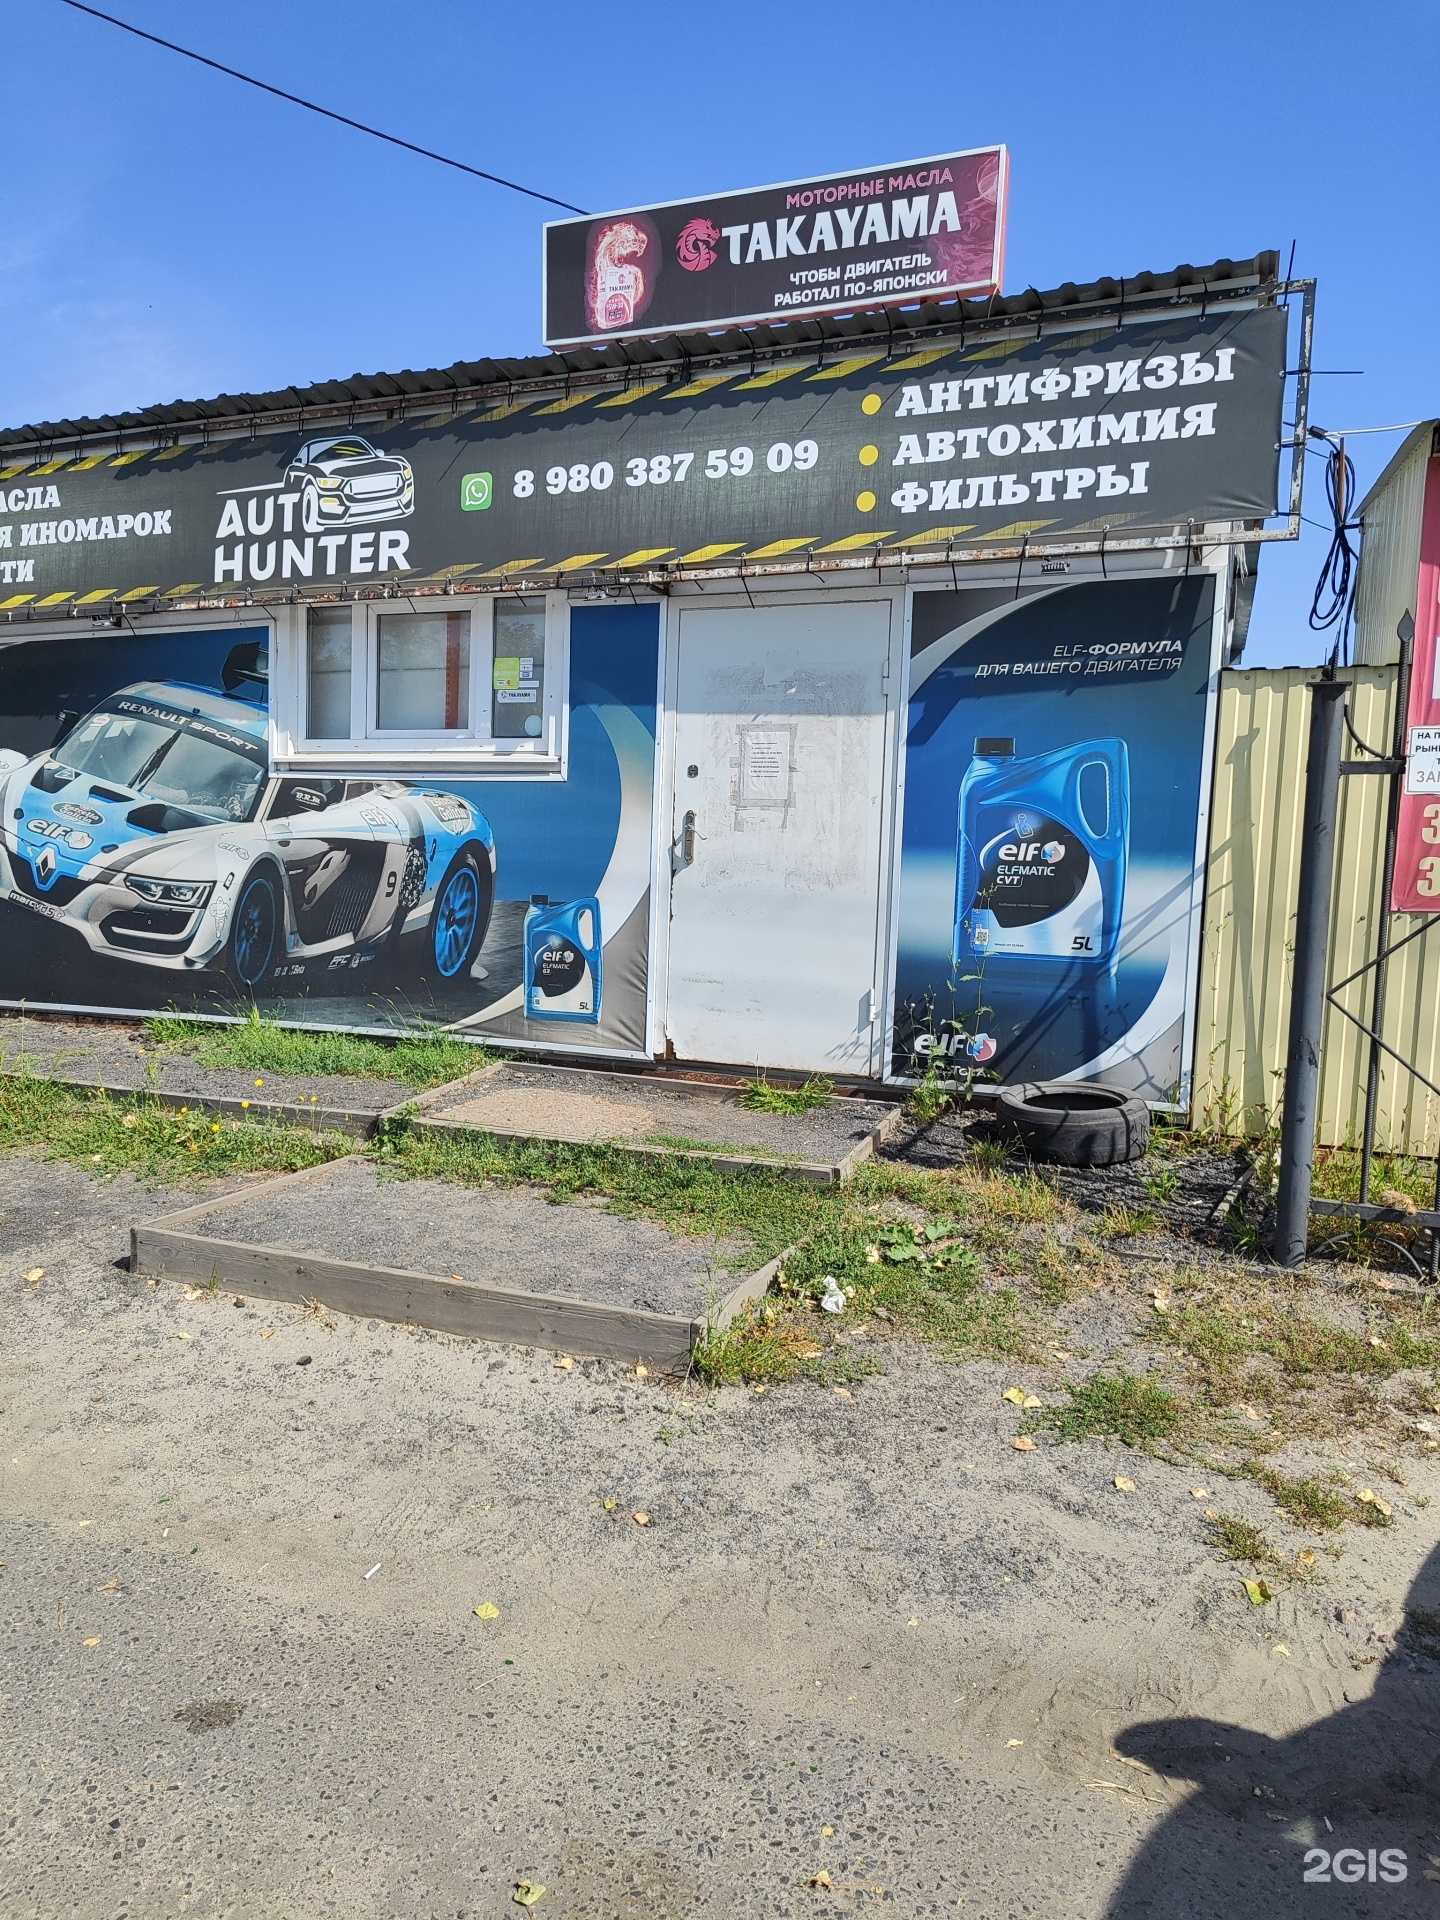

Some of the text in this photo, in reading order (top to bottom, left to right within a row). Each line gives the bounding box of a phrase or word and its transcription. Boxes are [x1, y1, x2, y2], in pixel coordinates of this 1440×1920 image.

[786, 167, 954, 210] МОТОРНЫЕ МАСЛА
[721, 190, 961, 265] TAKAYAMA
[790, 253, 932, 286] ЧТОБЫ ДВИГАТЕЛЬ
[774, 269, 948, 307] РАБОТАЛ ПО-ЯПОНСКИ
[895, 348, 1235, 417] АНТИФРИЗЫ
[892, 402, 1218, 466] АВТОХИМИЯ
[513, 439, 819, 498] 8 980 387 59 09
[890, 461, 1150, 513] ФИЛЬТРЫ
[20, 510, 172, 546] ИНОМАРОК
[214, 530, 411, 583] HUNTER
[975, 657, 1183, 678] ДЛЯ ВАШЕГО ДВИГАТЕЛЯ
[118, 701, 258, 750] RENAULT SPORT
[1416, 771, 1440, 783] ЗА
[998, 843, 1041, 861] elf
[385, 871, 398, 897] 9
[996, 876, 1020, 885] CVT
[997, 865, 1055, 876] ELFMATIC
[543, 951, 563, 961] elf
[1071, 936, 1093, 951] 5L
[579, 1001, 589, 1010] 5L
